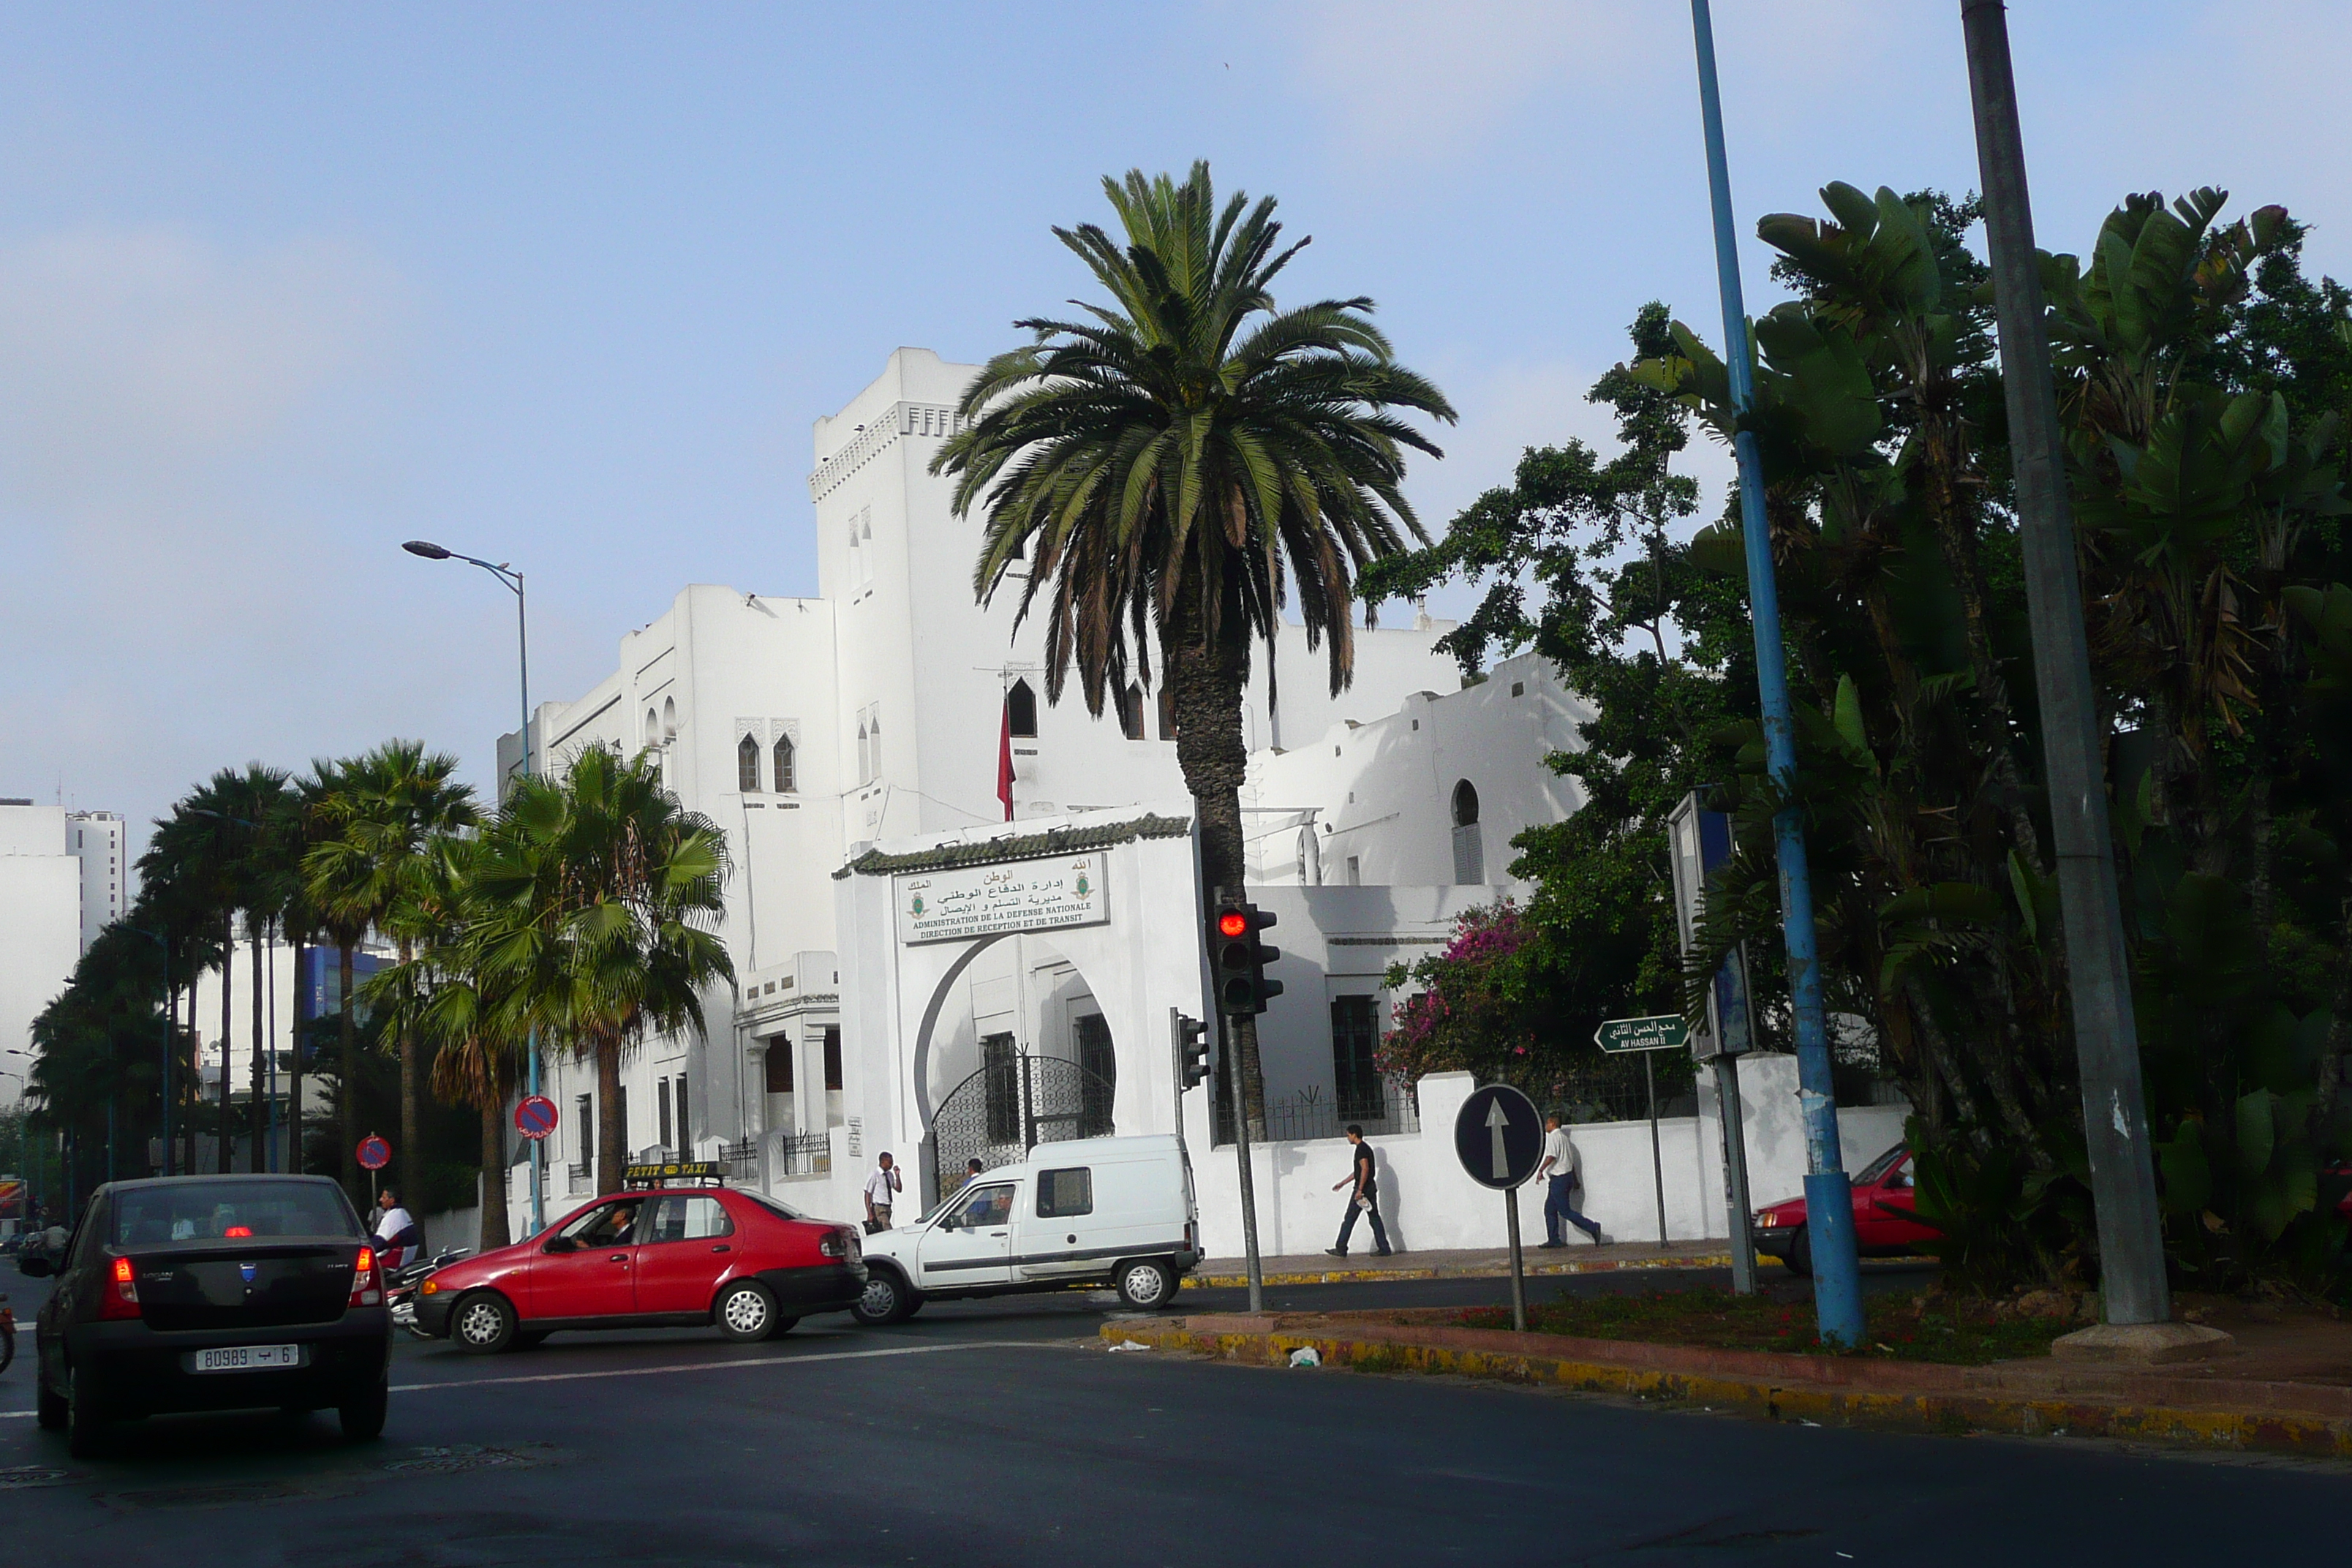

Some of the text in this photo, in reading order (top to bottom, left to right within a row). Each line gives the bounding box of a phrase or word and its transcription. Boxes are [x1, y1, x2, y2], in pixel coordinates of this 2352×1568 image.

[908, 856, 1091, 891] الله الوطن الملك
[938, 879, 1063, 904] إدارة الدفاع الوطني
[1028, 894, 1062, 905] مديرية
[913, 902, 1091, 930] ADMINISTRATION DE LA DEFENSE NATIONALE
[981, 903, 988, 911] و
[921, 927, 962, 938] DIRECTION
[977, 920, 1021, 932] RECEPTION
[1023, 919, 1034, 927] ET
[1036, 918, 1047, 926] DE
[1049, 913, 1083, 924] TRANSIT
[1609, 1020, 1676, 1039] محج الحسن الثاني
[1621, 1036, 1666, 1048] AV HASSAN II
[626, 1165, 660, 1177] PETIT
[682, 1164, 708, 1174] TAXI
[206, 1349, 248, 1368] 80989
[282, 1346, 290, 1362] 6
